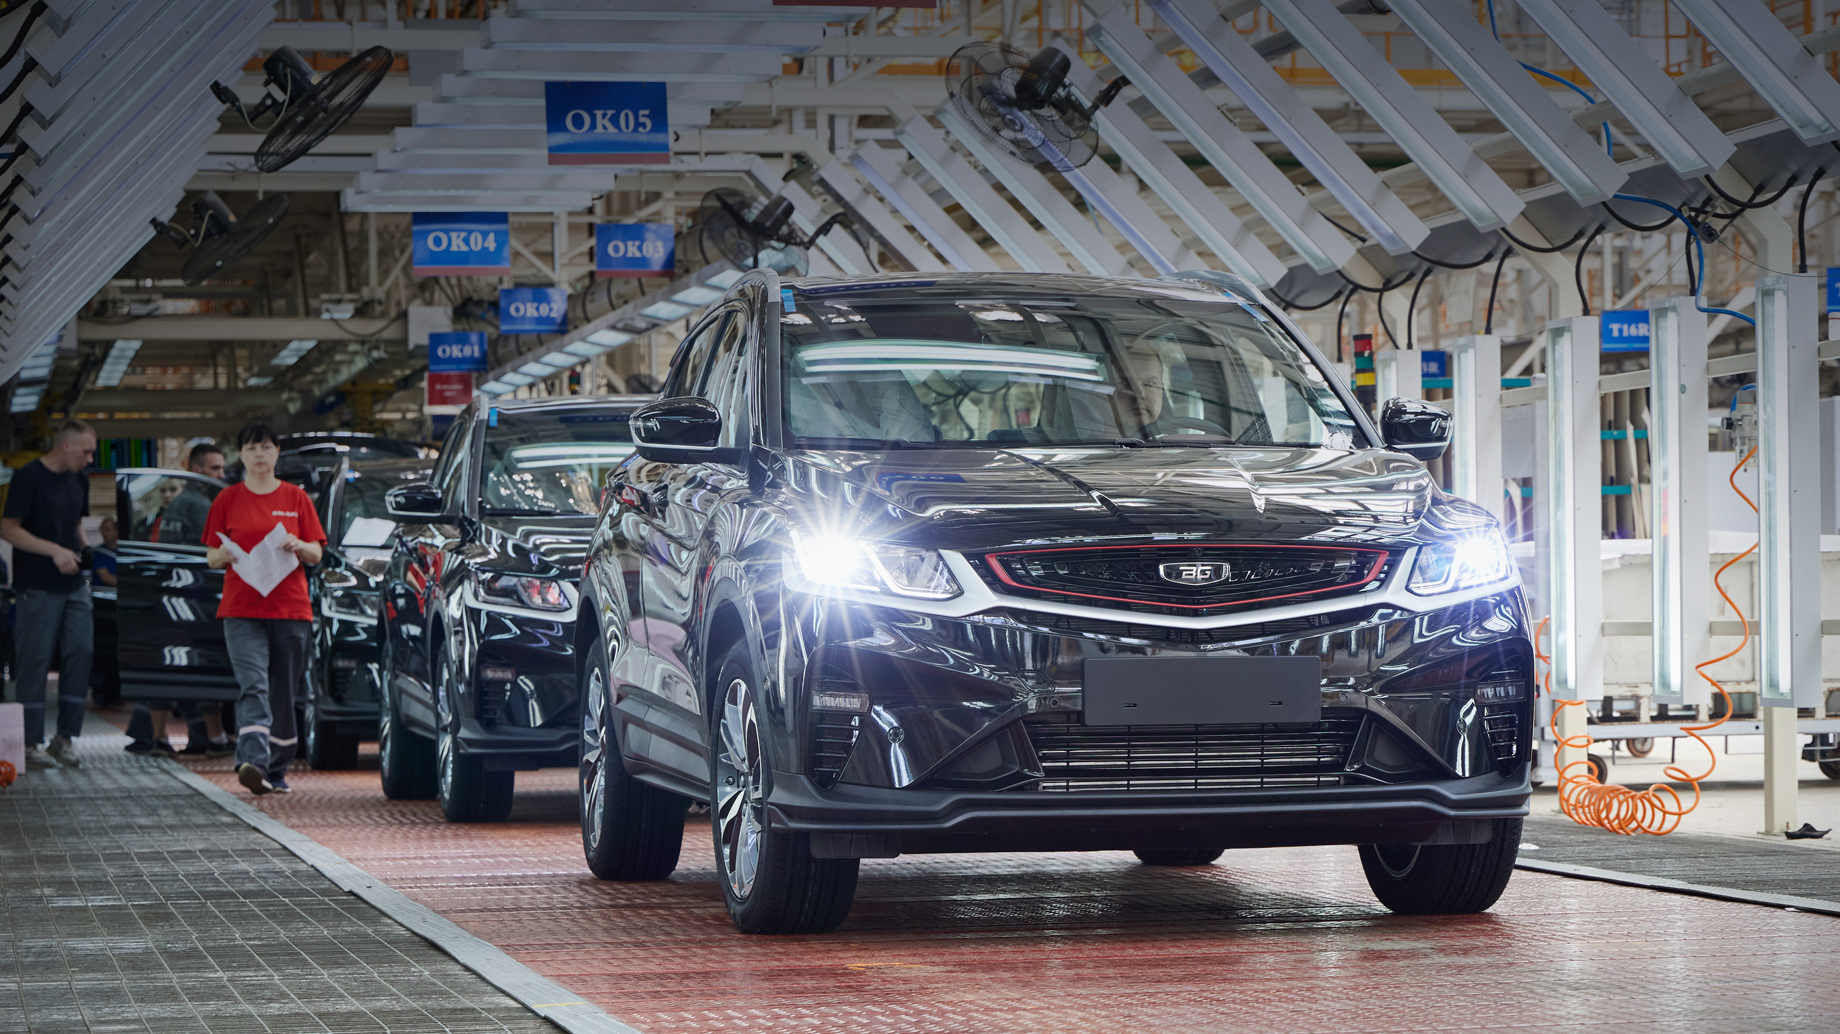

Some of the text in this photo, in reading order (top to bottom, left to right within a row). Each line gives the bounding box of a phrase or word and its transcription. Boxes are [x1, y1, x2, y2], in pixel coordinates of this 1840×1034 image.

[565, 109, 653, 134] OK05
[427, 231, 497, 252] OK04
[607, 240, 665, 258] OK03
[509, 302, 559, 318] OK02
[1608, 322, 1650, 337] T16R
[437, 344, 480, 359] OK01
